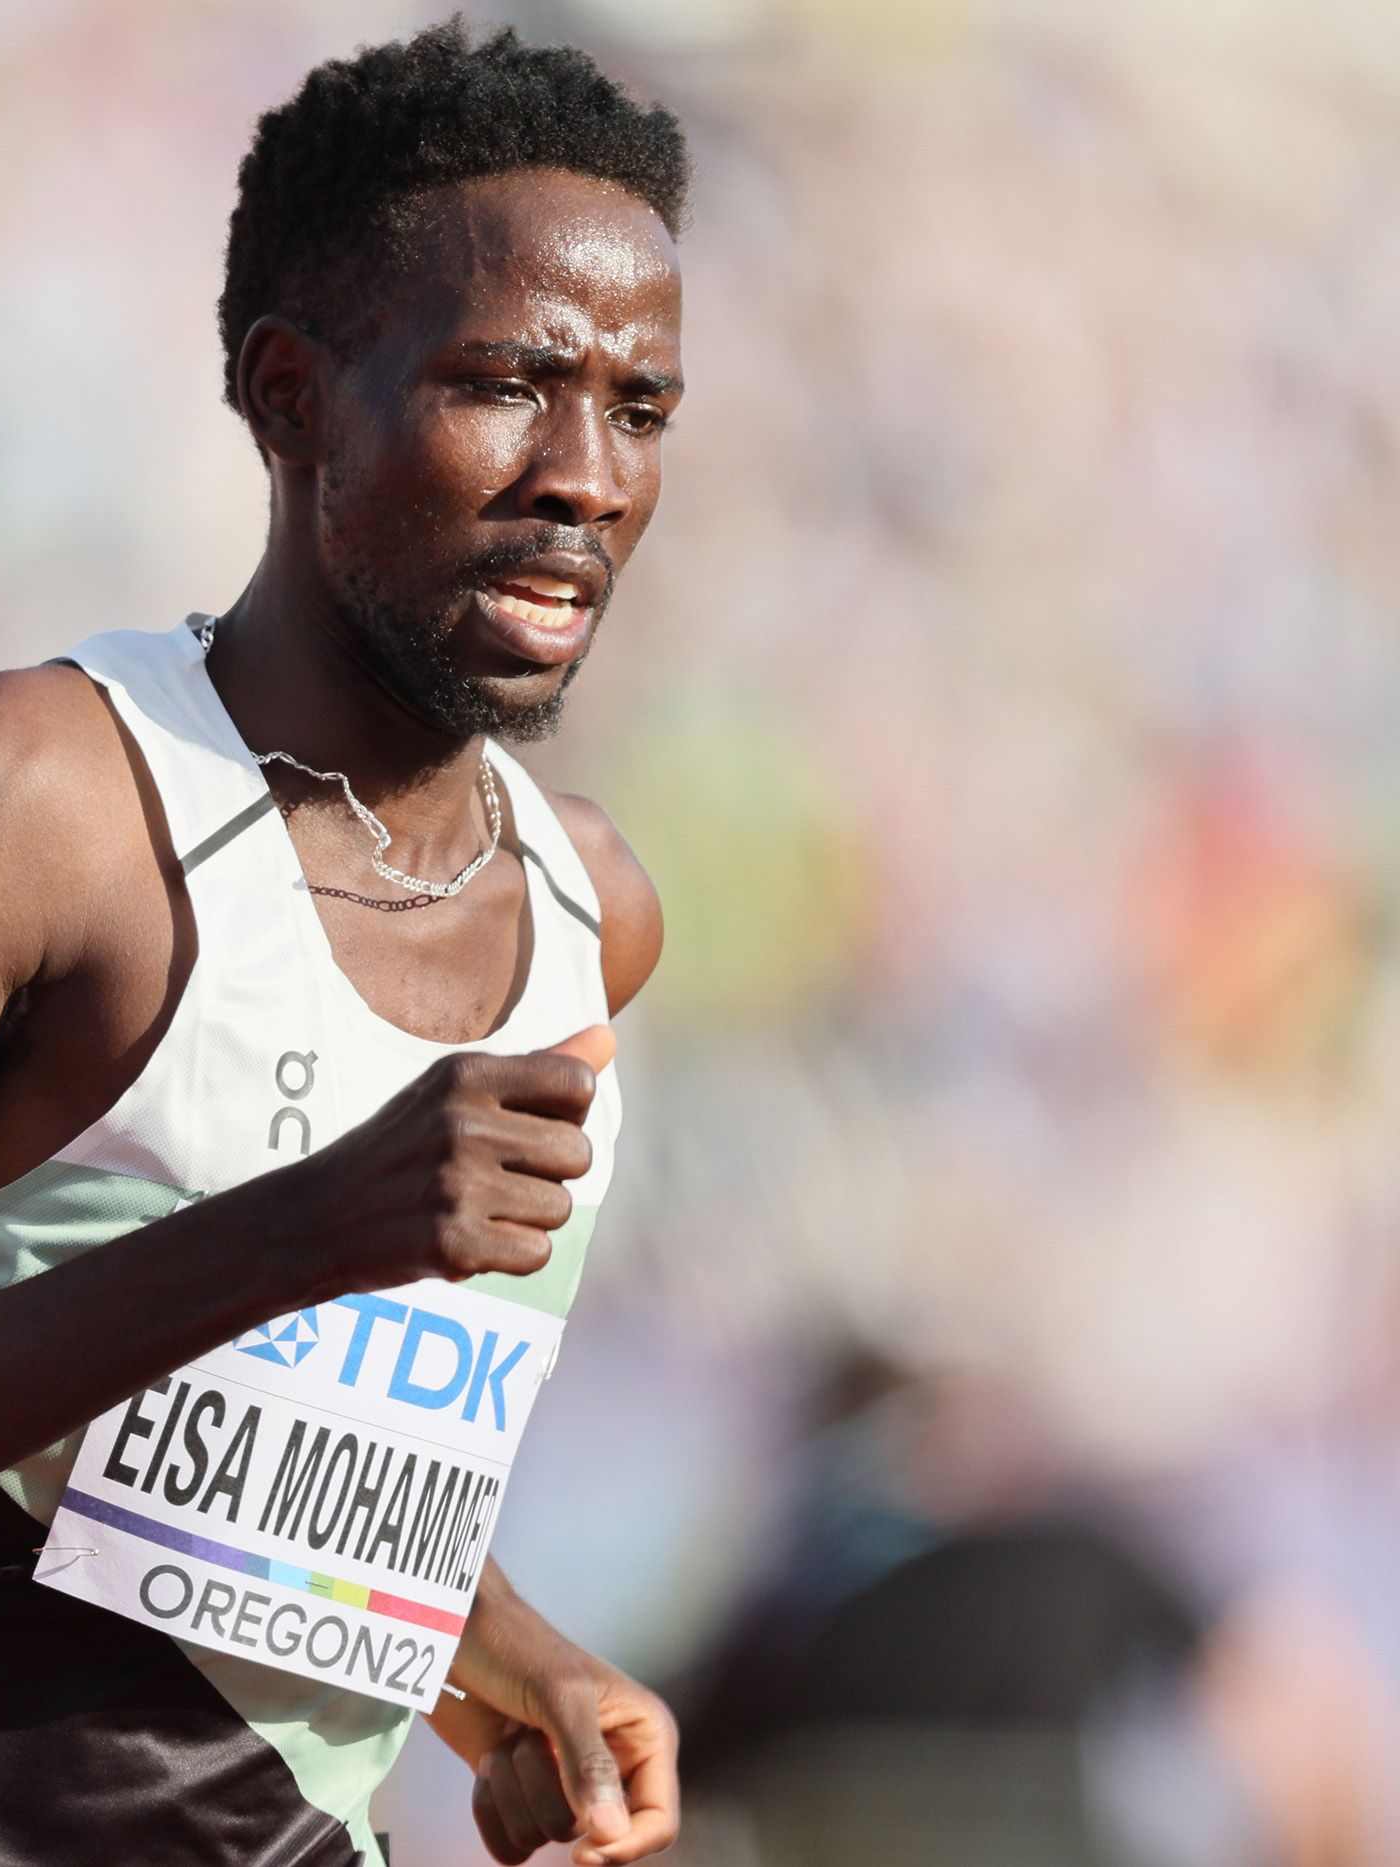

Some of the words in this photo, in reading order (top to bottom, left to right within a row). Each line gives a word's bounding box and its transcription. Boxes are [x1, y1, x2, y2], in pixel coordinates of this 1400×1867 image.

[331, 1292, 531, 1432] TDK
[102, 1376, 262, 1523] EISA
[139, 1564, 436, 1697] OREGON22
